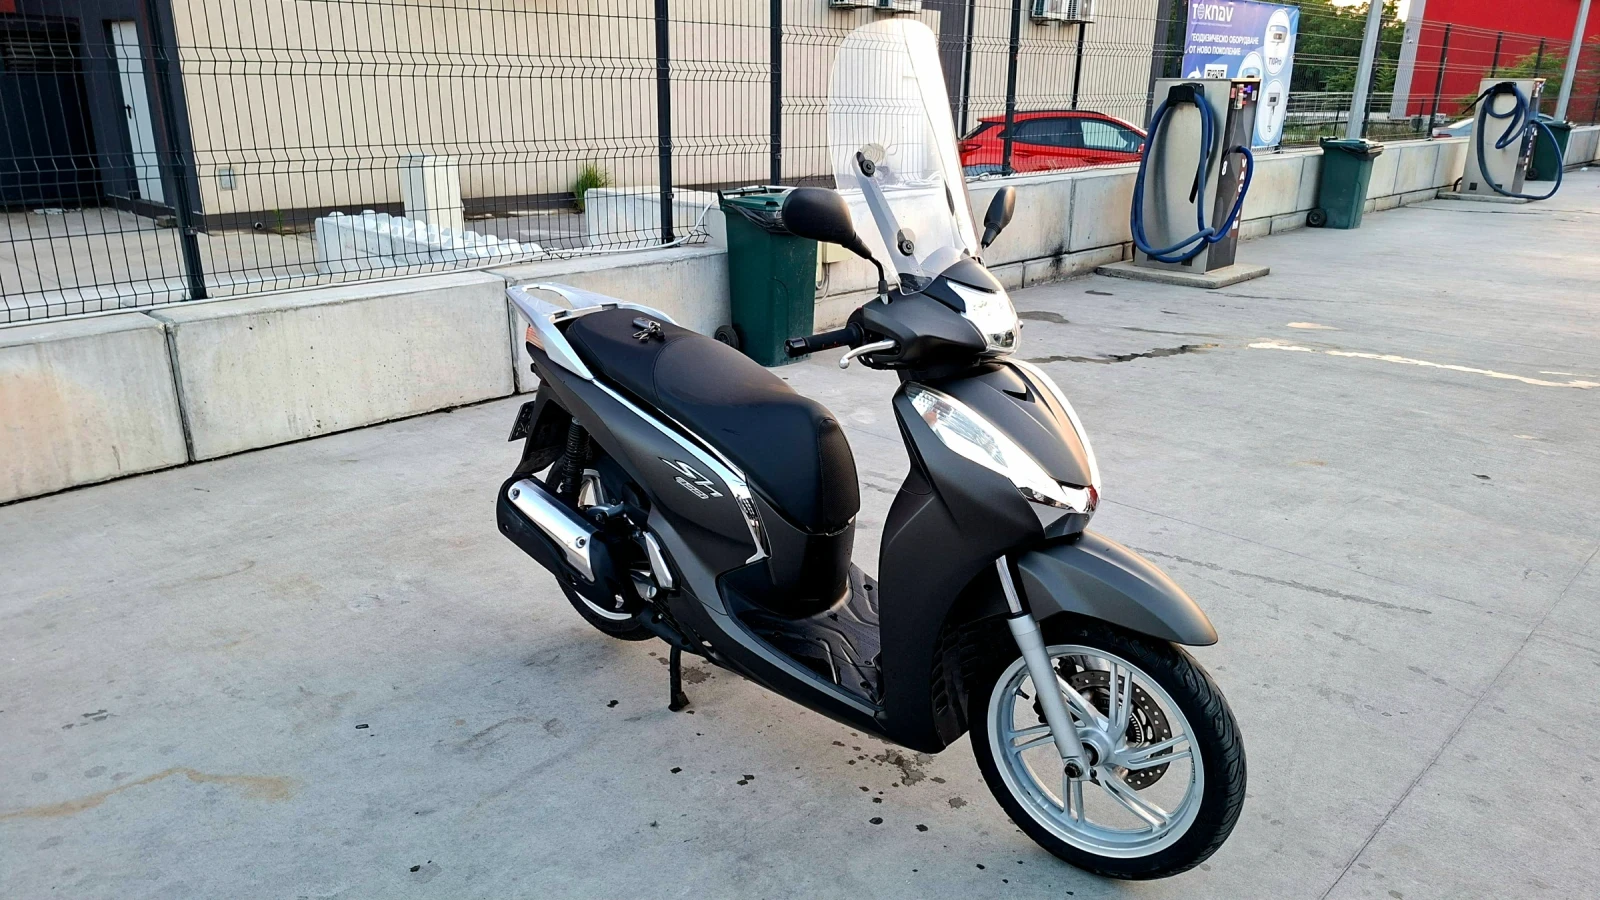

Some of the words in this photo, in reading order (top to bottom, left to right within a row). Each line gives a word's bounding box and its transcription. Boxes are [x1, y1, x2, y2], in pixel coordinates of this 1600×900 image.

[1189, 45, 1196, 54] ОТ
[1197, 46, 1212, 54] НОВО
[1221, 160, 1228, 176] 8
[658, 457, 724, 497] SH
